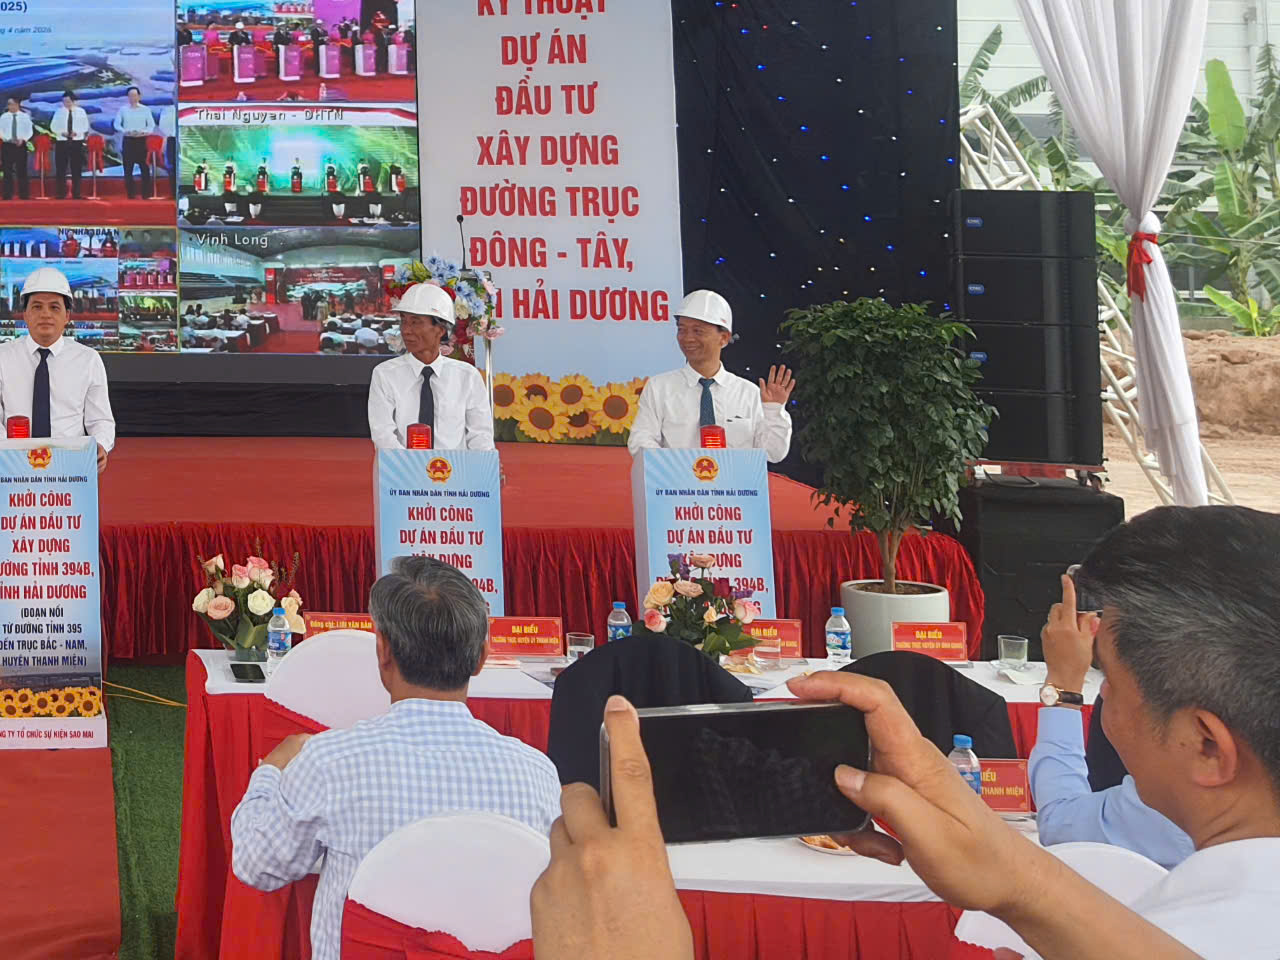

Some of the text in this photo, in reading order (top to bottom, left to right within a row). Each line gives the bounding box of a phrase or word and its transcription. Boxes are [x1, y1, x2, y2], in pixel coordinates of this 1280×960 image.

[501, 28, 586, 71] DỰ ÁN
[495, 75, 598, 115] ĐẦU TƯ
[477, 130, 619, 172] XÂY DỰNG
[460, 179, 639, 223] ĐƯỜNG TRỤC
[235, 233, 268, 248] Long
[470, 231, 547, 268] ĐÔNG
[576, 231, 633, 272] TÂY,
[513, 279, 559, 319] HẢI
[570, 287, 669, 321] DƯƠNG
[9, 489, 71, 507] KHỞI CÔNG
[408, 502, 472, 522] KHỞI CÔNG
[675, 502, 741, 520] KHỞI CÔNG
[1, 515, 17, 533] DỰ
[20, 513, 36, 530] ÁN
[67, 514, 81, 529] TƯ
[12, 536, 70, 556] XÂY DỰNG
[32, 557, 58, 576] TỈNH
[62, 562, 94, 577] 394B,
[24, 581, 43, 599] HẢI
[47, 584, 86, 599] DƯƠNG
[67, 624, 82, 633] 395
[32, 656, 59, 666] THANH
